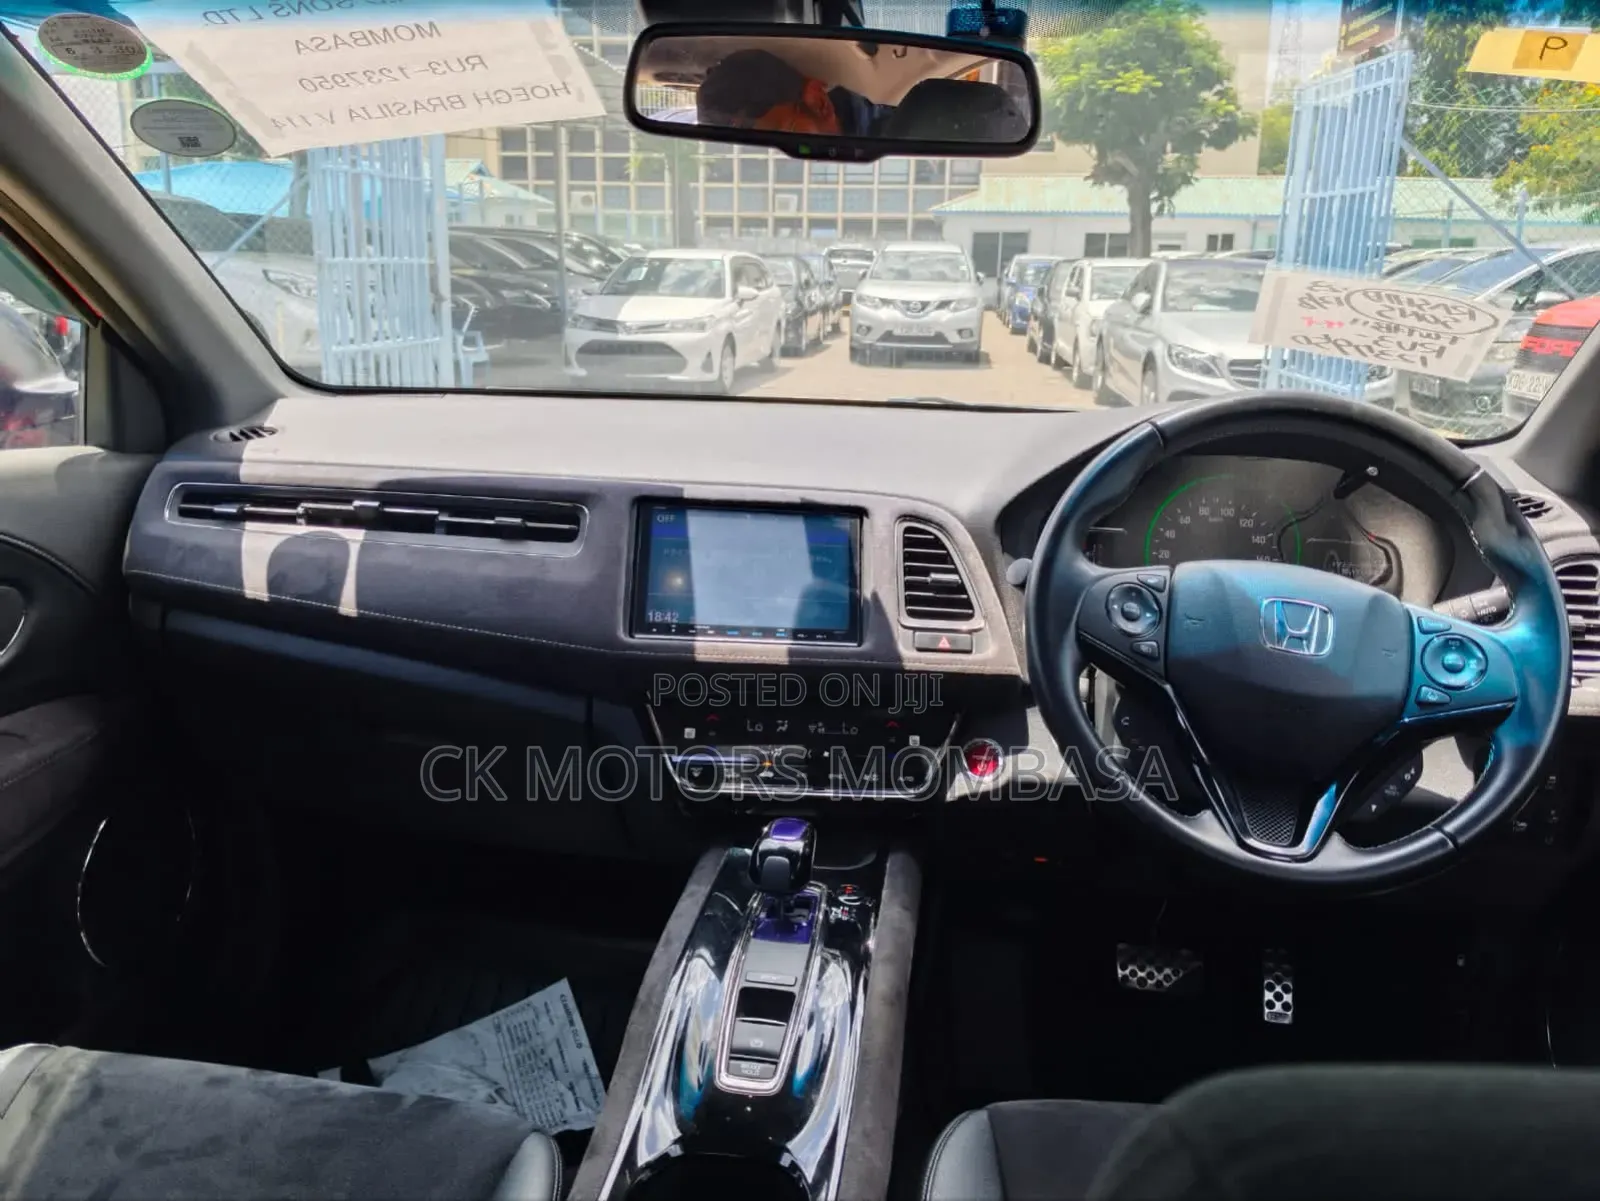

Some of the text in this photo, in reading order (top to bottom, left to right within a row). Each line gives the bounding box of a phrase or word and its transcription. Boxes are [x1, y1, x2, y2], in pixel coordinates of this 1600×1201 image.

[1199, 506, 1235, 517] 80 100
[656, 514, 676, 523] OFF
[1179, 516, 1191, 525] 60
[1239, 518, 1254, 528] 120
[1164, 529, 1176, 539] 40
[1251, 535, 1266, 544] 140
[1158, 550, 1170, 559] 20
[647, 611, 679, 622] 18:42
